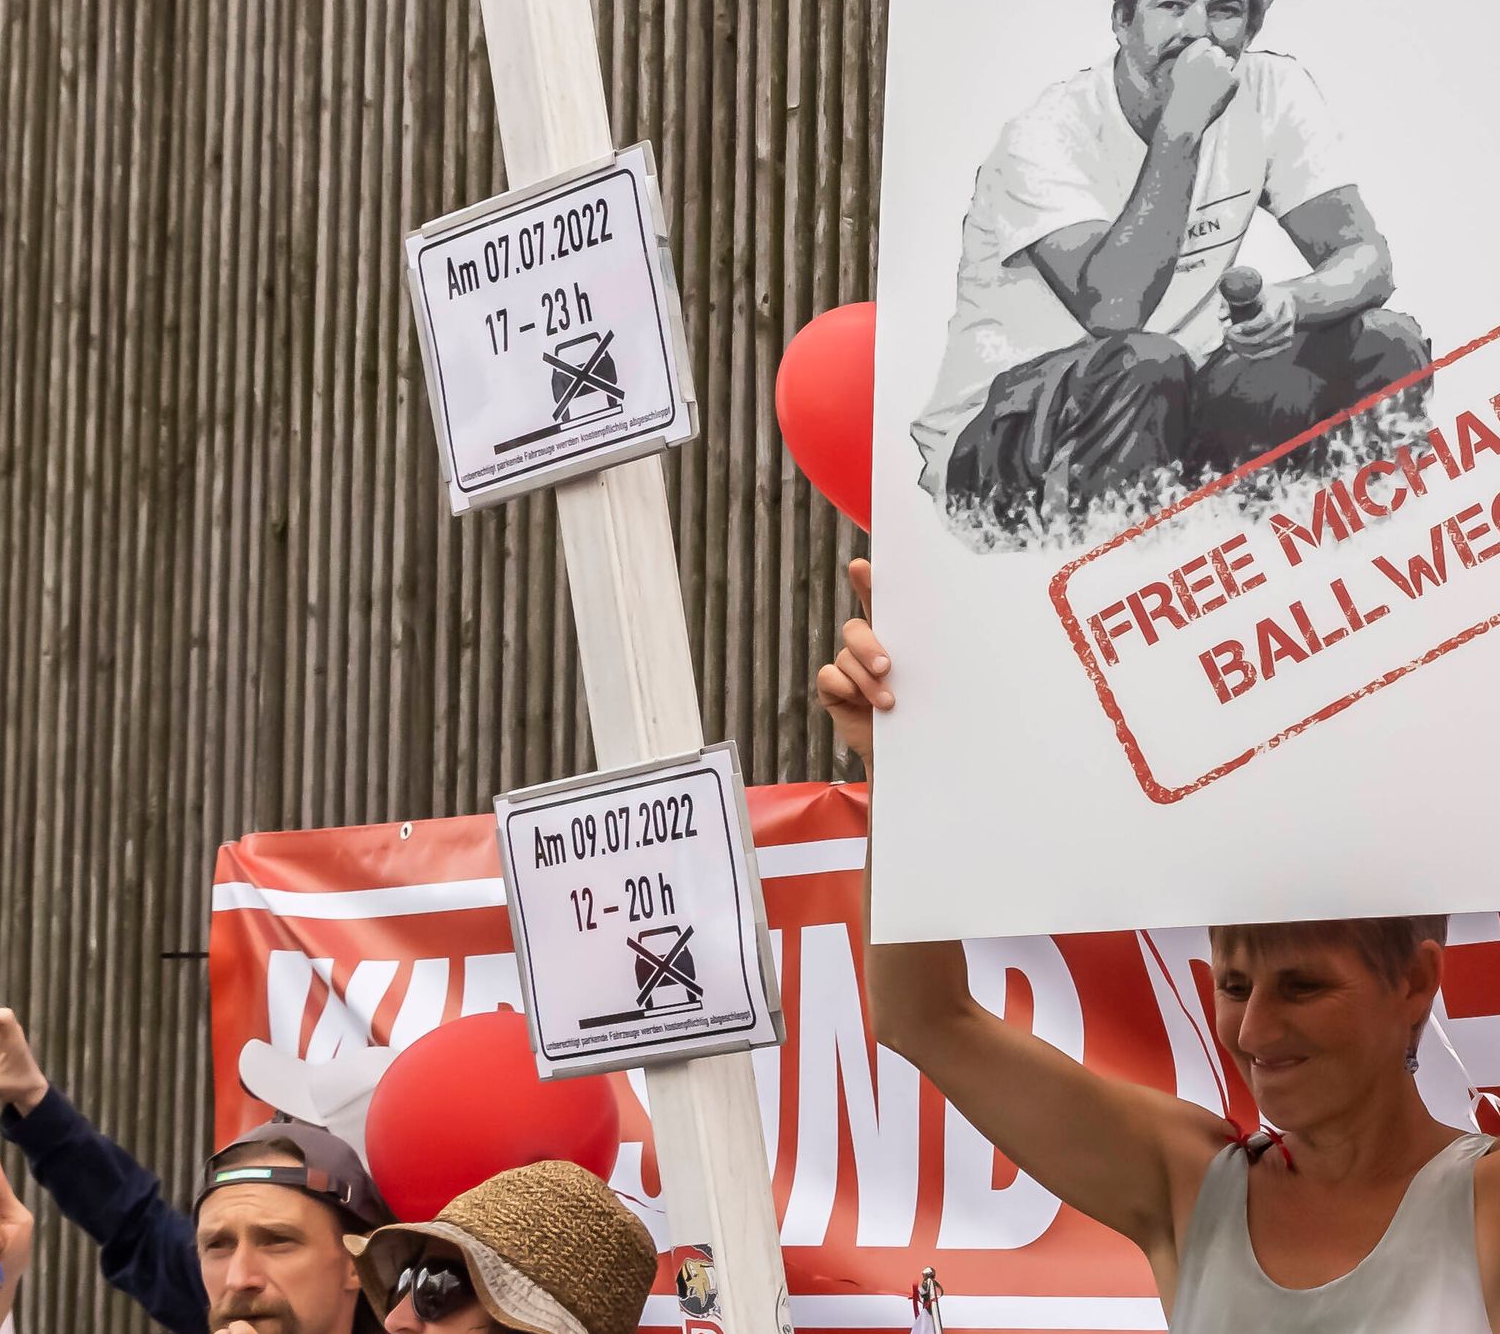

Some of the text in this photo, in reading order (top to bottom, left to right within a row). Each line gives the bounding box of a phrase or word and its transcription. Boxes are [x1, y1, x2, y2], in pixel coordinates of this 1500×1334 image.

[446, 197, 613, 300] Am 07.07.2022
[485, 308, 509, 356] 17
[541, 287, 572, 337] 23
[573, 282, 593, 324] h
[1086, 533, 1267, 667] FREE
[534, 793, 698, 869] Am 09.07.2022
[570, 887, 597, 932] 12
[625, 876, 654, 922] 20
[658, 872, 675, 915] h
